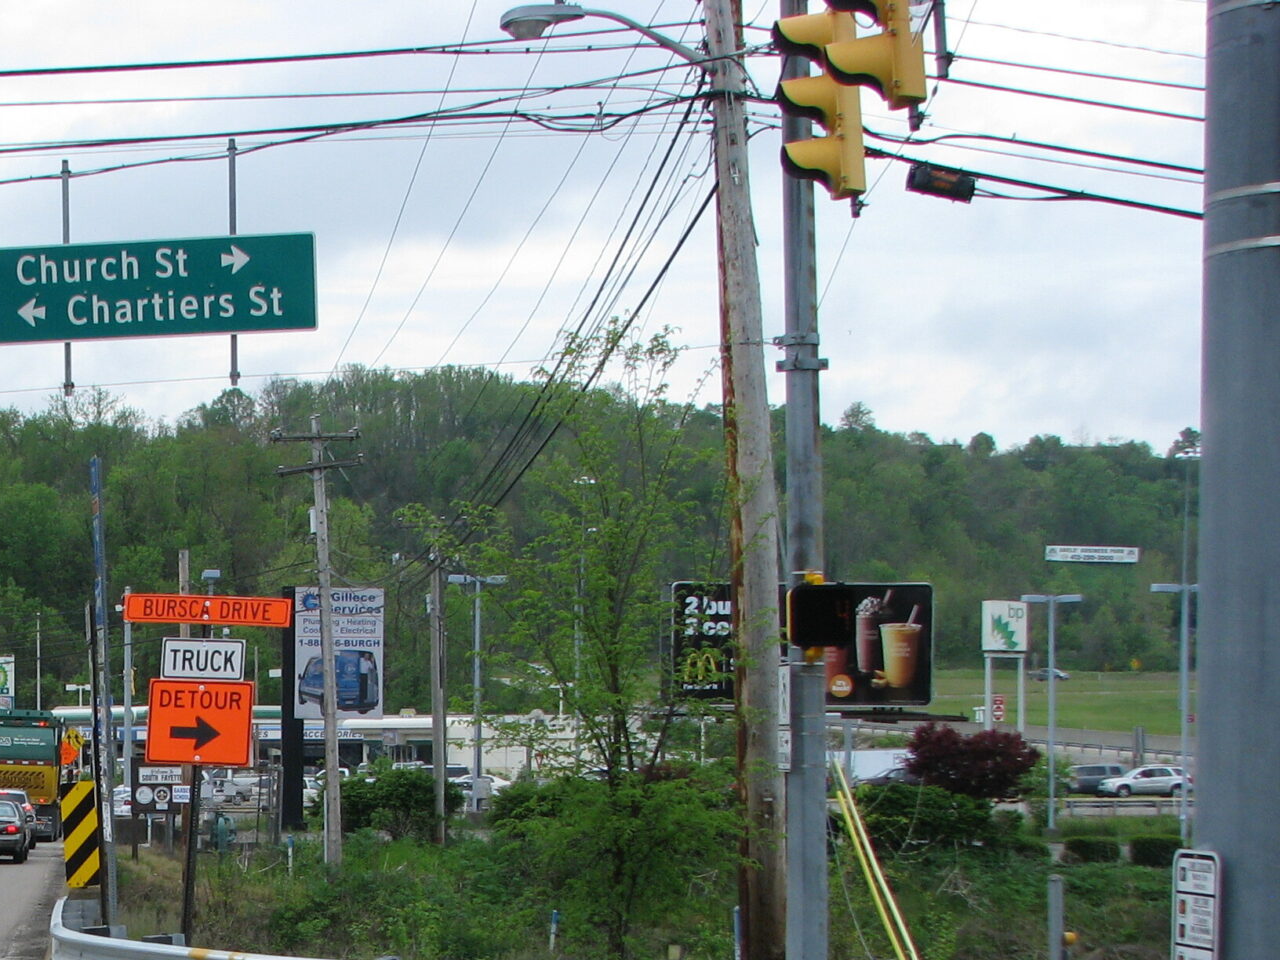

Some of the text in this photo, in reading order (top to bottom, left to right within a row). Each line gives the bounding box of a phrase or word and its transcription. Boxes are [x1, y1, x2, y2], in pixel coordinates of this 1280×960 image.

[17, 248, 188, 285] Church St
[67, 285, 283, 325] Chartiers St
[331, 592, 376, 602] Gillece
[703, 596, 731, 615] bu
[143, 598, 272, 621] BURSCA DRIVE
[331, 604, 381, 614] ervices
[1008, 605, 1024, 622] bp
[703, 621, 733, 635] co
[170, 648, 236, 672] TRUCK
[160, 690, 242, 710] DETOUR
